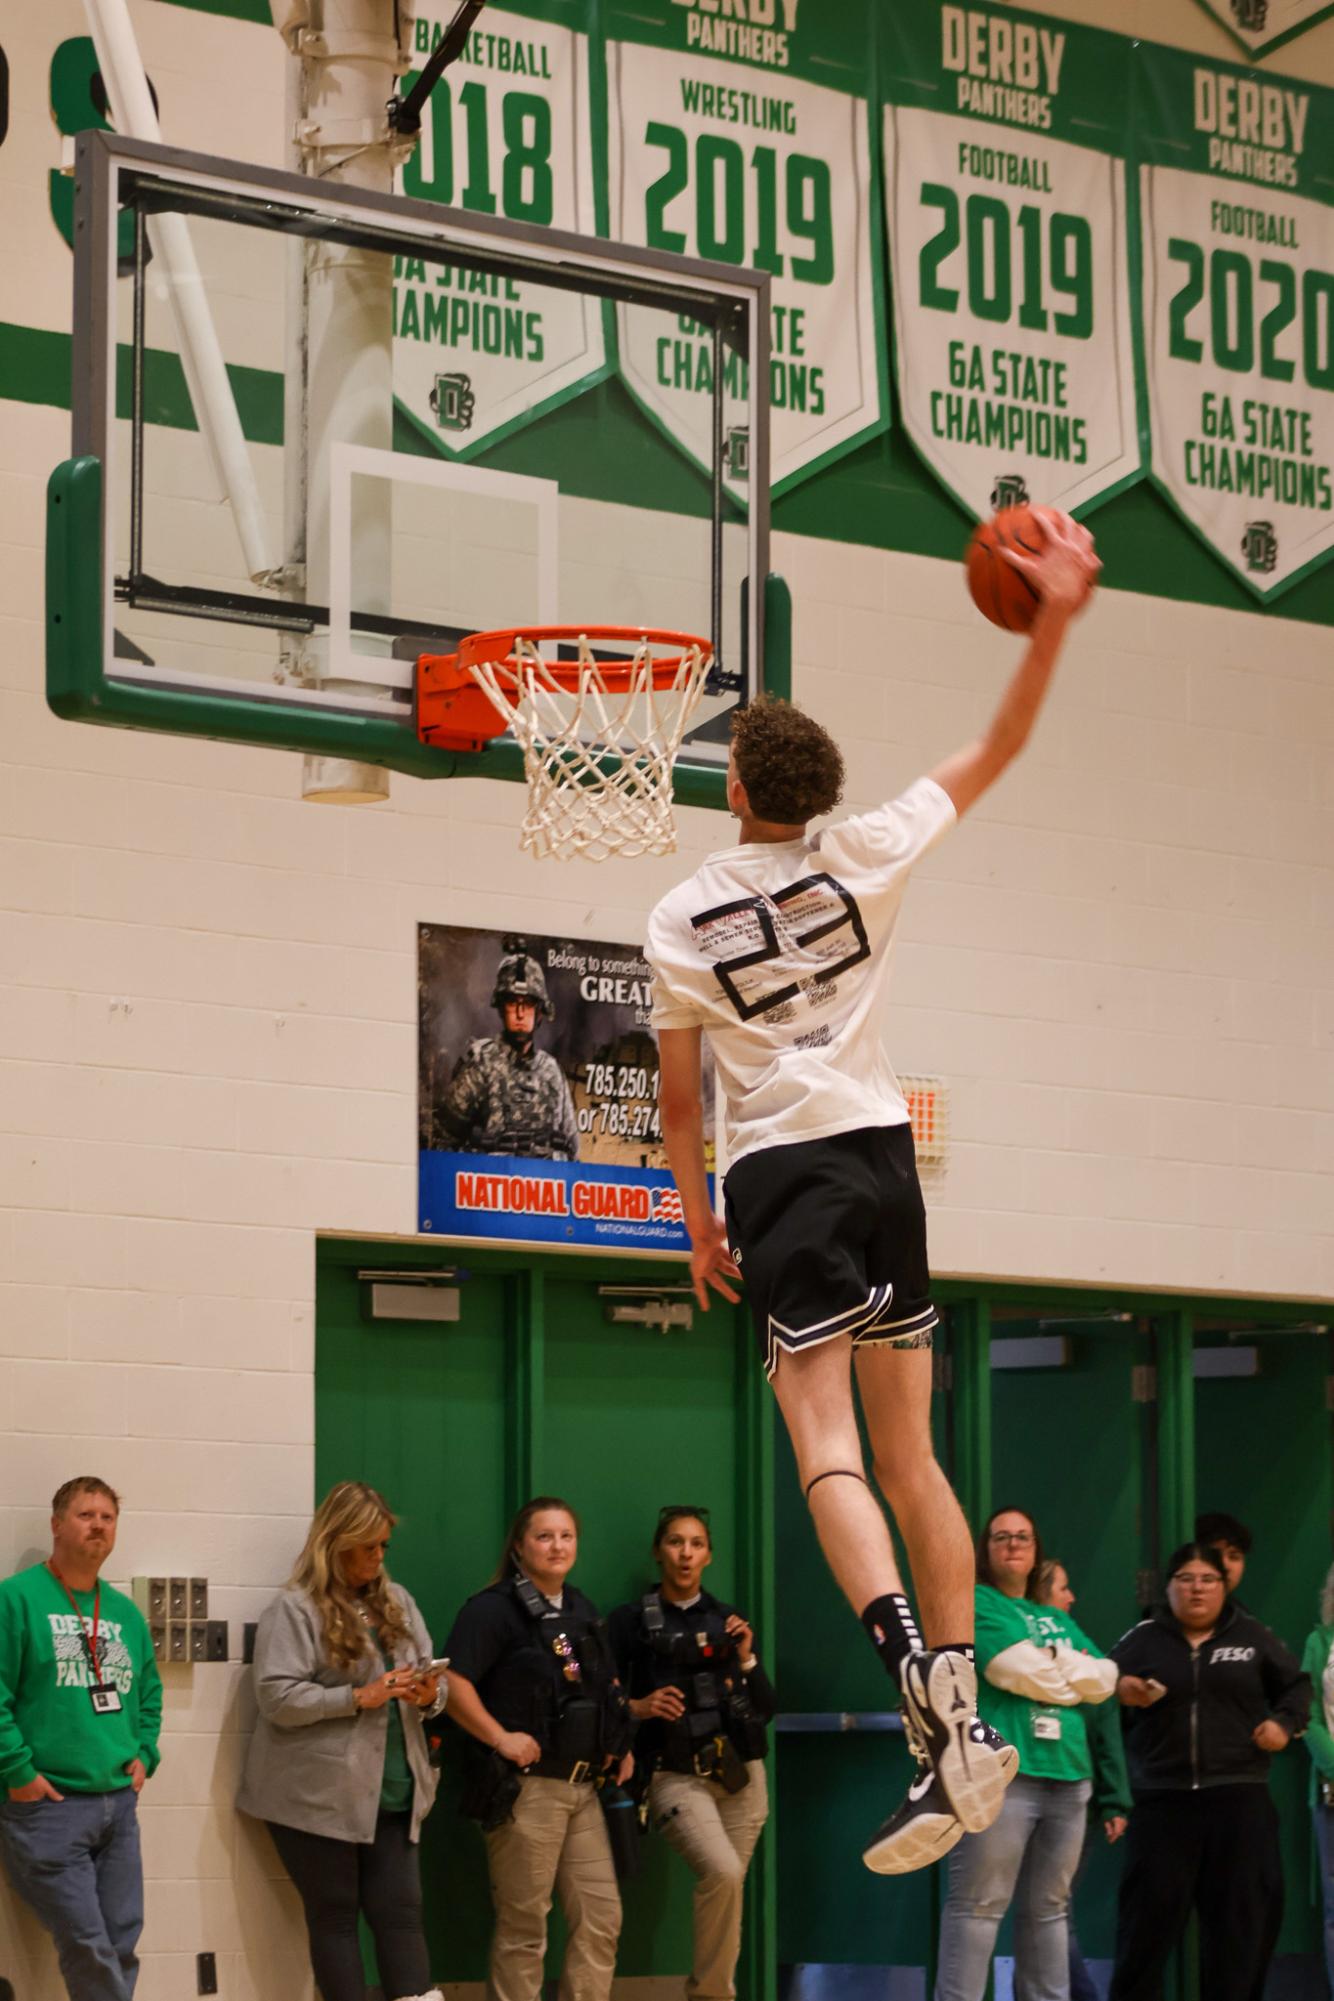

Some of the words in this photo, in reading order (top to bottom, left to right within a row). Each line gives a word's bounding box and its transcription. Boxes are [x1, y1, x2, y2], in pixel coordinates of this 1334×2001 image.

[416, 18, 552, 79] BAKETBALL
[687, 12, 789, 67] PANTHERS
[942, 5, 1066, 95] DERBY
[680, 78, 796, 135] WRESTLING
[957, 77, 1052, 129] PANTHERS
[1194, 69, 1310, 155] DERBY
[400, 69, 553, 227] 018
[958, 142, 1053, 193] FOOTBALL
[1209, 137, 1297, 186] PANTHERS
[645, 121, 835, 286] 2019
[1211, 201, 1299, 248] FOOTBALL
[919, 182, 1094, 340] 2019
[392, 287, 544, 363] AMPIONS
[1168, 238, 1334, 393] 2020
[656, 336, 825, 417] CHAMONS
[948, 341, 986, 393] 6A
[992, 350, 1067, 408] STATE
[930, 390, 1087, 465] CHAMPIONS
[1202, 392, 1236, 442] 6A
[1243, 400, 1313, 456] STATE
[1184, 440, 1333, 511] CHAMPIONS
[547, 949, 587, 976] Belong
[588, 956, 600, 971] to
[578, 1108, 597, 1132] or
[456, 1172, 570, 1215] NATIONAL
[572, 1180, 650, 1222] GUARD
[595, 1224, 685, 1239] NATIONALGUARD.com
[48, 1614, 122, 1642] DERBY
